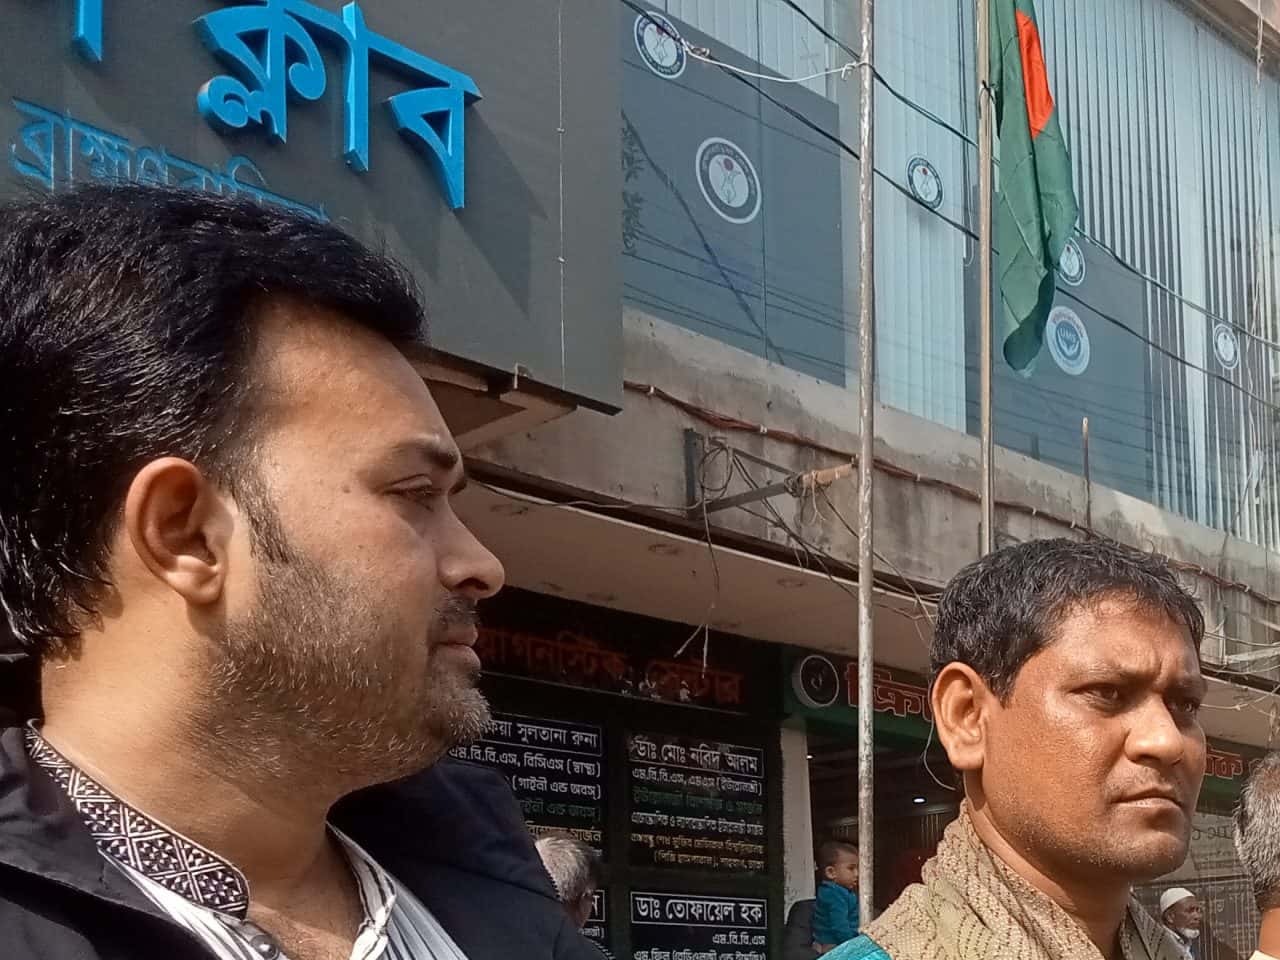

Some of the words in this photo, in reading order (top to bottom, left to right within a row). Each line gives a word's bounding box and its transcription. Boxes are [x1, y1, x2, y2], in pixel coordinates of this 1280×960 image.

[193, 0, 482, 209] ক্লাব
[515, 722, 568, 745] সুলতানা
[570, 729, 599, 748] রুনা
[635, 896, 661, 919] ডাঃ
[665, 899, 736, 922] তোফায়েল
[738, 902, 764, 923] হক
